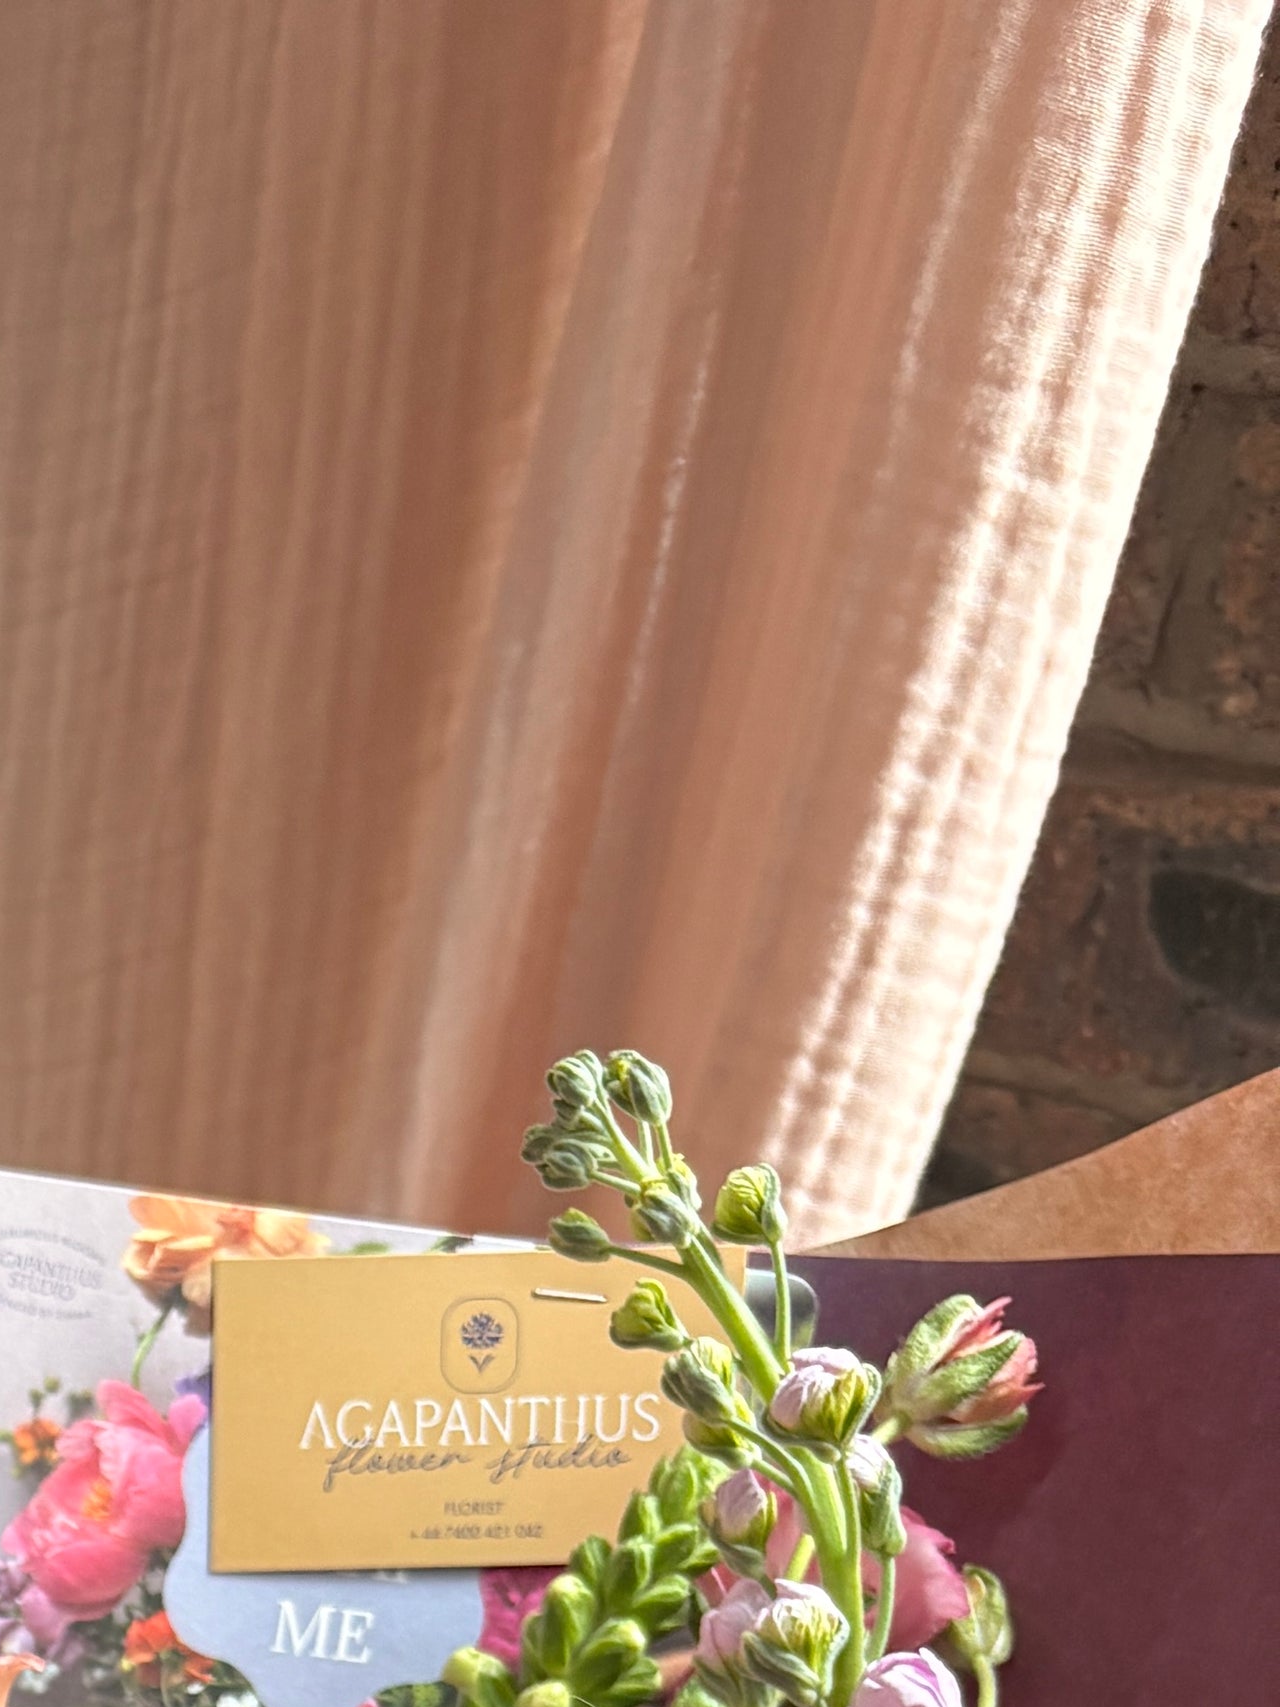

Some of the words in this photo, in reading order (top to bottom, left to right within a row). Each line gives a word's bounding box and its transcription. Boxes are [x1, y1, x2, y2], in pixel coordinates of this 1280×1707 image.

[298, 1393, 662, 1450] AGAPANTHUS
[322, 1434, 472, 1493] flower
[485, 1432, 631, 1484] studio
[268, 1600, 376, 1664] ME
